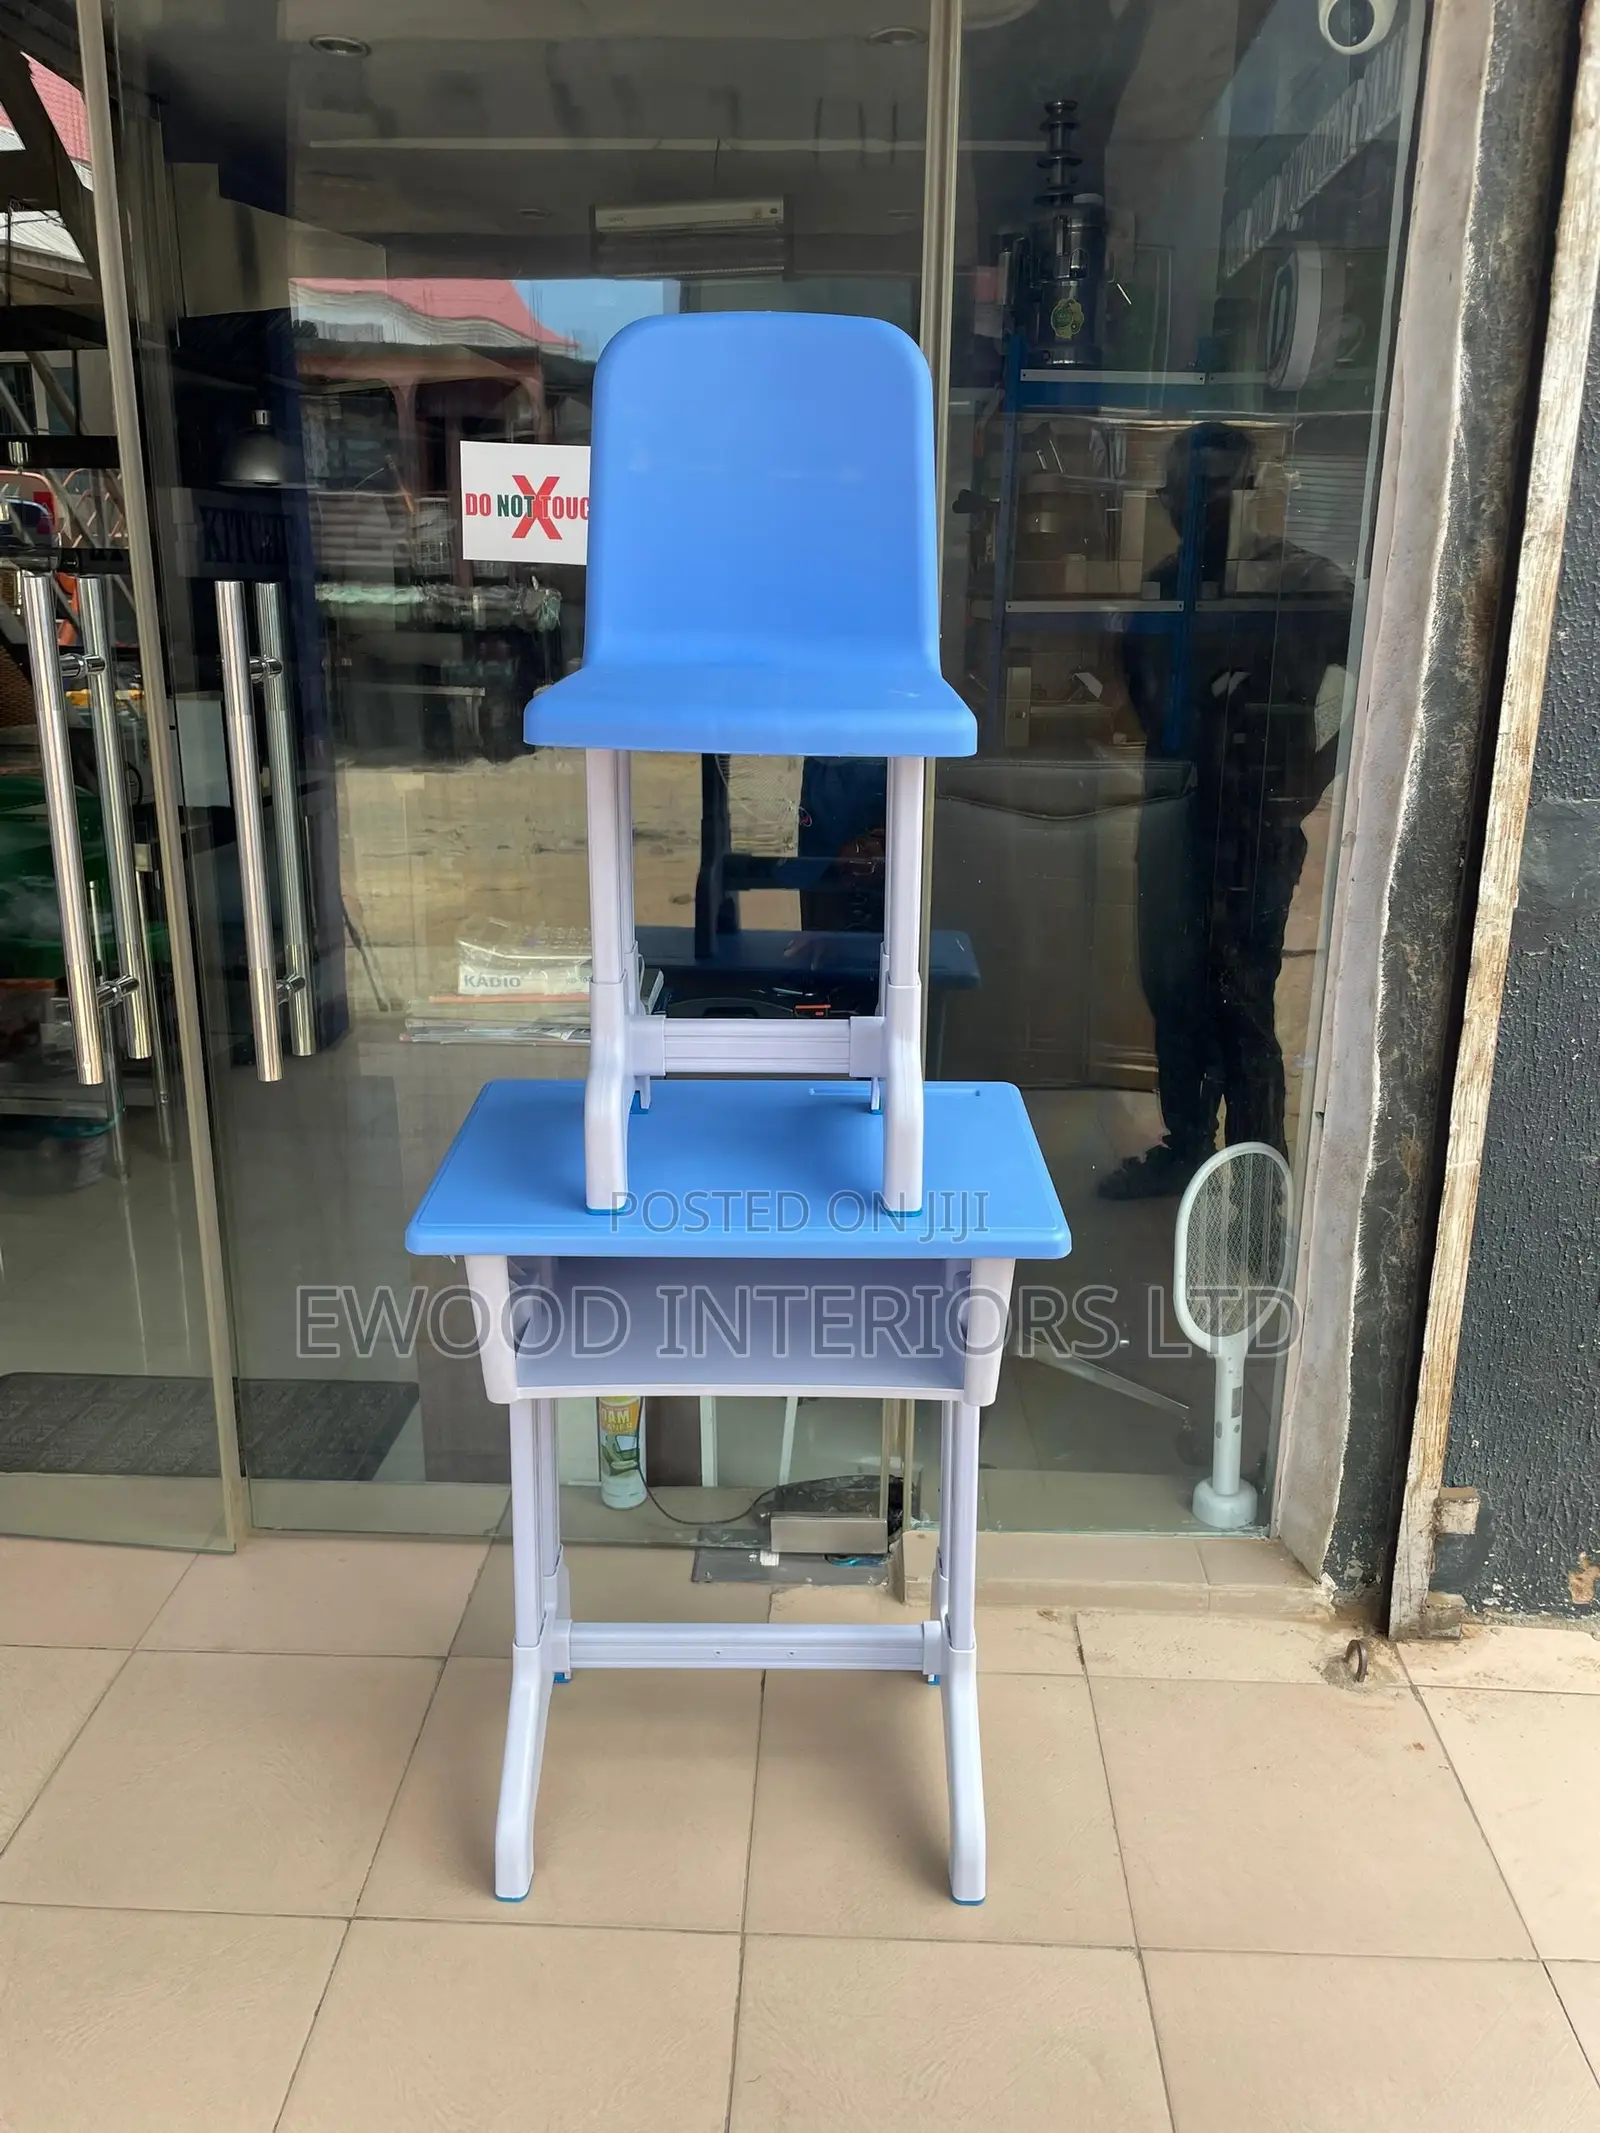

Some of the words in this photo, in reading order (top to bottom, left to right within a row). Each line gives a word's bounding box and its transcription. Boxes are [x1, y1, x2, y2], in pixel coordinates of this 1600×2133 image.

[465, 492, 492, 517] DO
[497, 494, 535, 518] NOT
[540, 496, 589, 520] TOUC
[463, 974, 521, 988] KADIO
